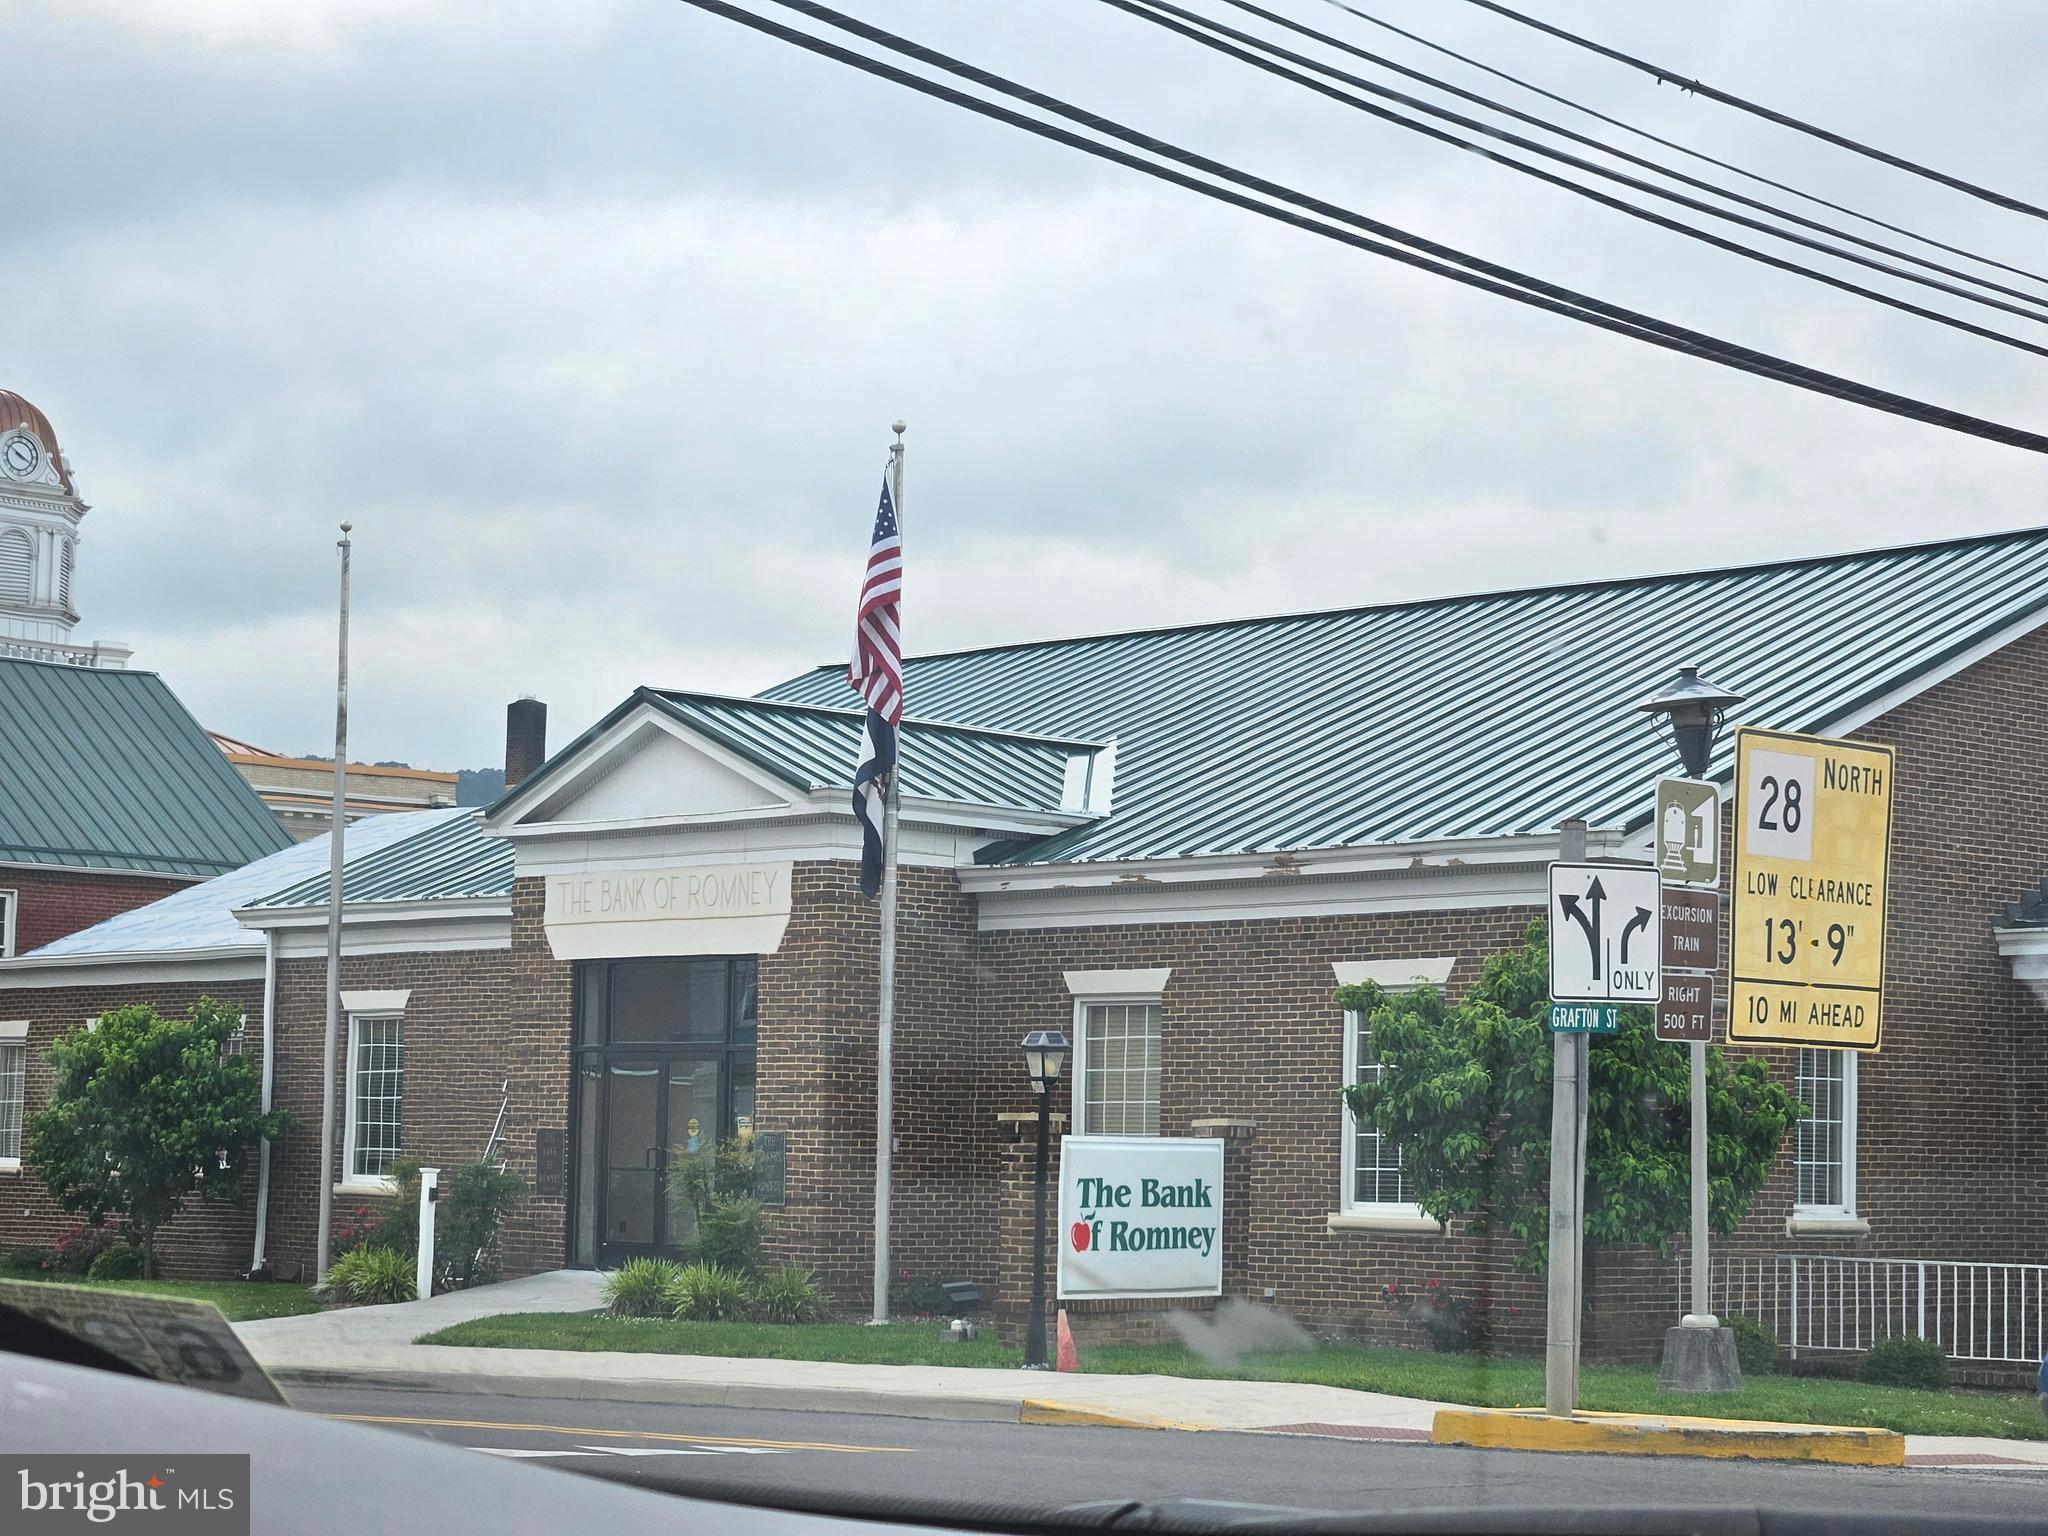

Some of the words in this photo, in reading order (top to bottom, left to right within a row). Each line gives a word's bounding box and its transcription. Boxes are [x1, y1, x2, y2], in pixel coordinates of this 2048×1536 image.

[1823, 757, 1883, 796] NORTH
[1758, 775, 1802, 834] 28
[557, 880, 593, 915] THE
[601, 877, 648, 913] BANK
[653, 874, 679, 911] OF
[688, 869, 779, 910] ROMNEY
[1747, 870, 1778, 897] LOW
[1790, 875, 1873, 907] CLEARANCE
[1661, 904, 1713, 924] EXCURSION
[1672, 935, 1700, 952] TRAIN
[1613, 970, 1655, 991] ONLY
[1668, 986, 1701, 1003] RIGHT
[1552, 1006, 1599, 1028] GRAFTON
[1606, 1008, 1618, 1029] ST
[1663, 1014, 1685, 1030] 500
[1691, 1014, 1705, 1030] FT
[1748, 995, 1769, 1025] 10
[1779, 999, 1797, 1024] MI
[1808, 1002, 1865, 1028] AHEAD
[1076, 1177, 1132, 1209] The
[1140, 1177, 1213, 1209] Bank
[1109, 1220, 1217, 1258] Romney
